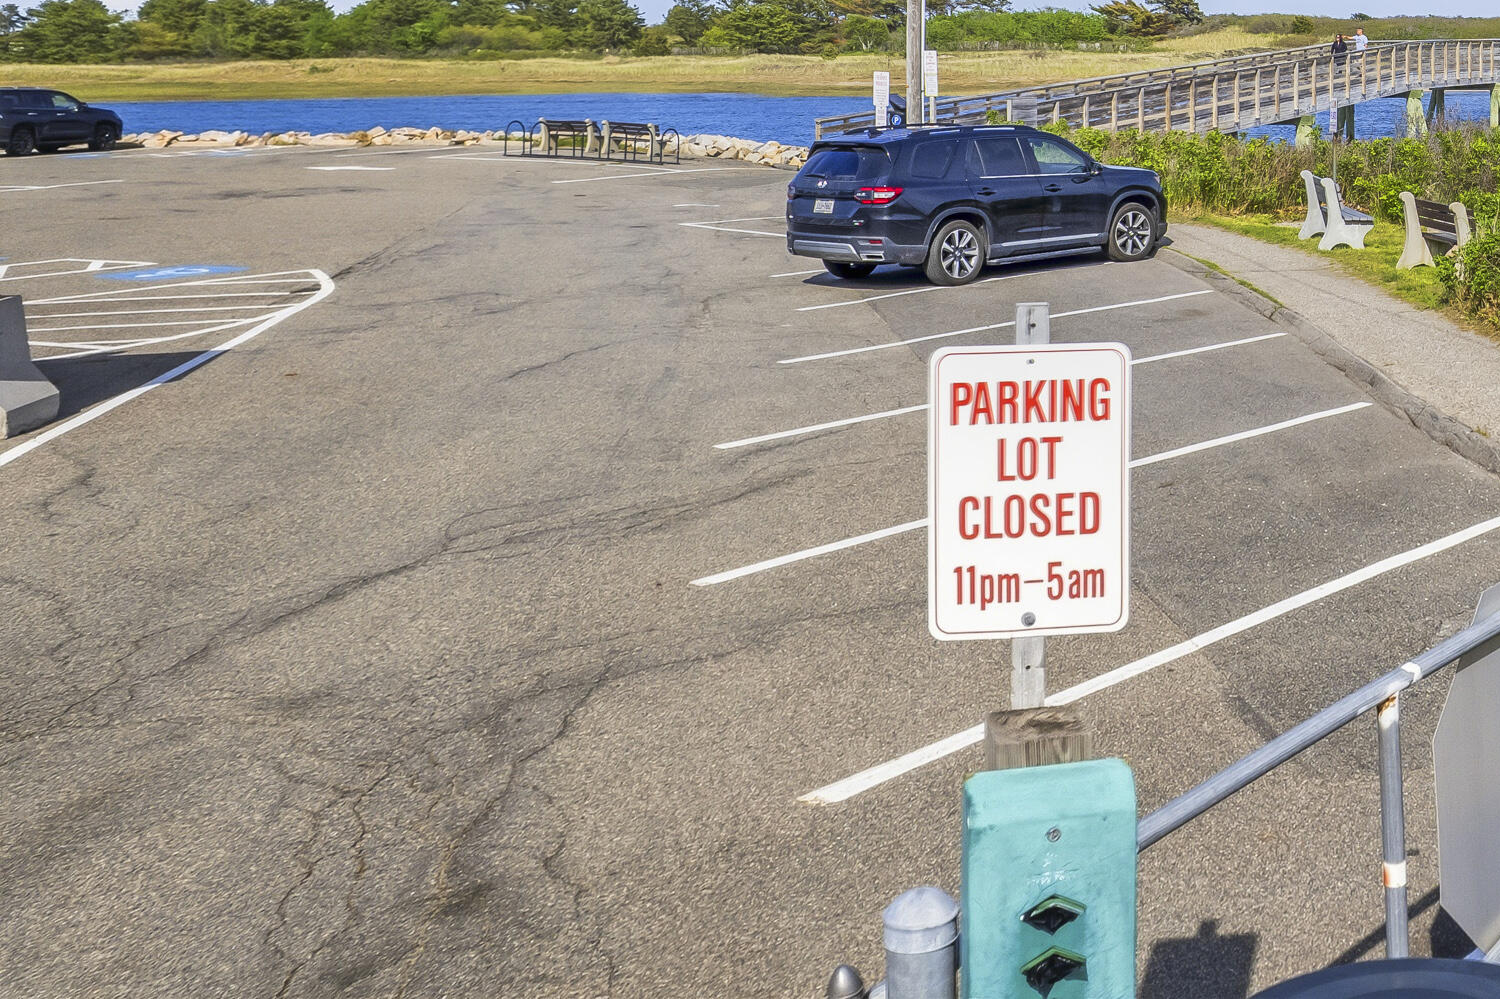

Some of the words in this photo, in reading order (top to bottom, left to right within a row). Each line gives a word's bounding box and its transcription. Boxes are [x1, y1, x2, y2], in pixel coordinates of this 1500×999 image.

[950, 377, 1111, 426] PARKING
[997, 436, 1063, 482] LOT
[959, 491, 1101, 540] CLOSED
